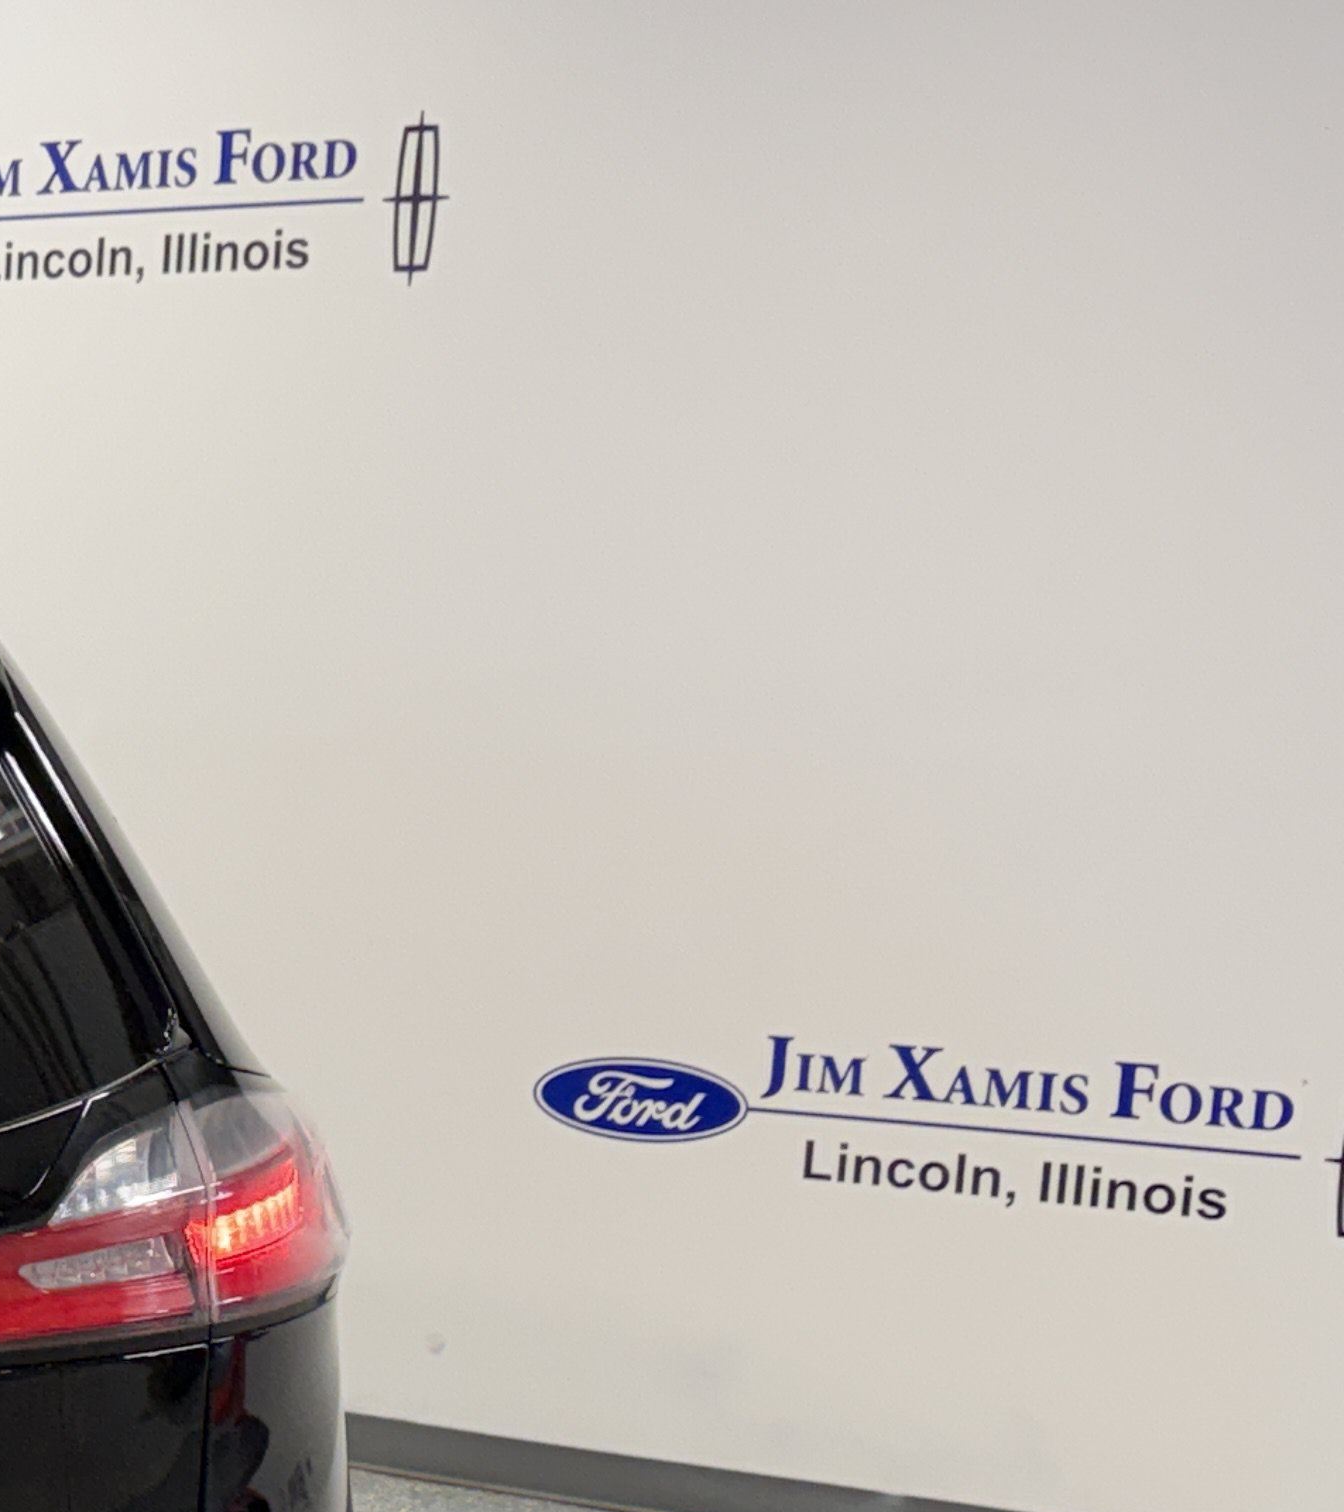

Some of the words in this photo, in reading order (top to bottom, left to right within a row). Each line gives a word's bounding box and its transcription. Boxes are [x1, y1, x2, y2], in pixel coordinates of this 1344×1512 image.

[36, 138, 199, 196] XAMIS
[213, 127, 359, 185] FORD
[162, 228, 311, 275] Illinois
[573, 1071, 705, 1134] Ford
[760, 1034, 867, 1100] JIM
[883, 1043, 1090, 1117] XAMIS
[1108, 1060, 1295, 1134] FORD
[801, 1138, 1018, 1207] Lincoln,
[1039, 1162, 1230, 1222] Illinois
